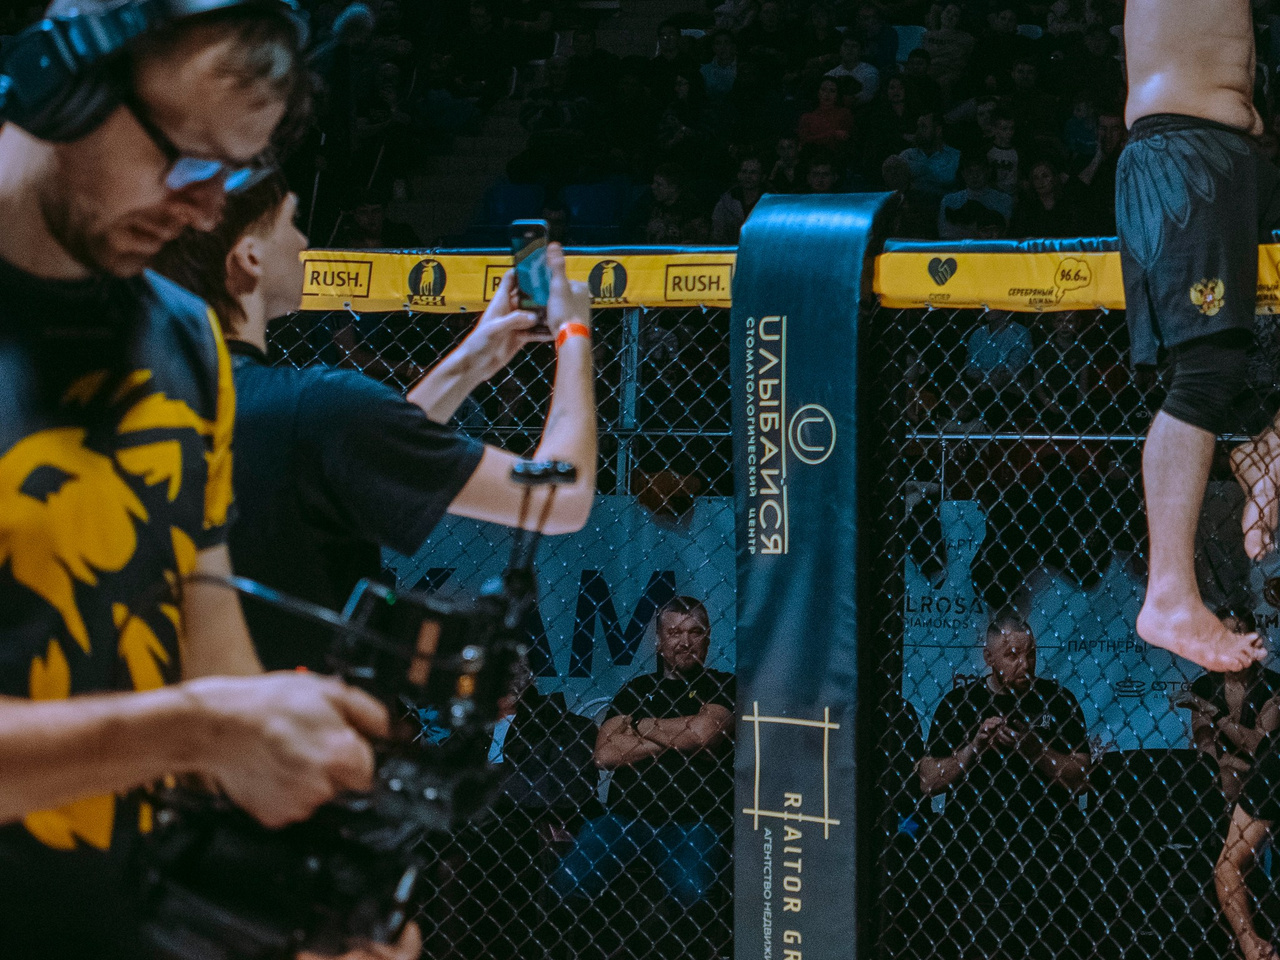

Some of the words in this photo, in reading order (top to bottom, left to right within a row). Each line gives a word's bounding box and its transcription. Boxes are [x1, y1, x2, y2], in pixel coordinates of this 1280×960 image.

[309, 271, 364, 289] RUSH.
[672, 274, 726, 292] RUSH.
[745, 316, 757, 498] СТОМАТОЛОГИЧЕСКИЙ
[748, 507, 757, 555] ЦЕНТР
[906, 596, 984, 614] LROSA
[763, 827, 773, 899] АГЕНТСТВО
